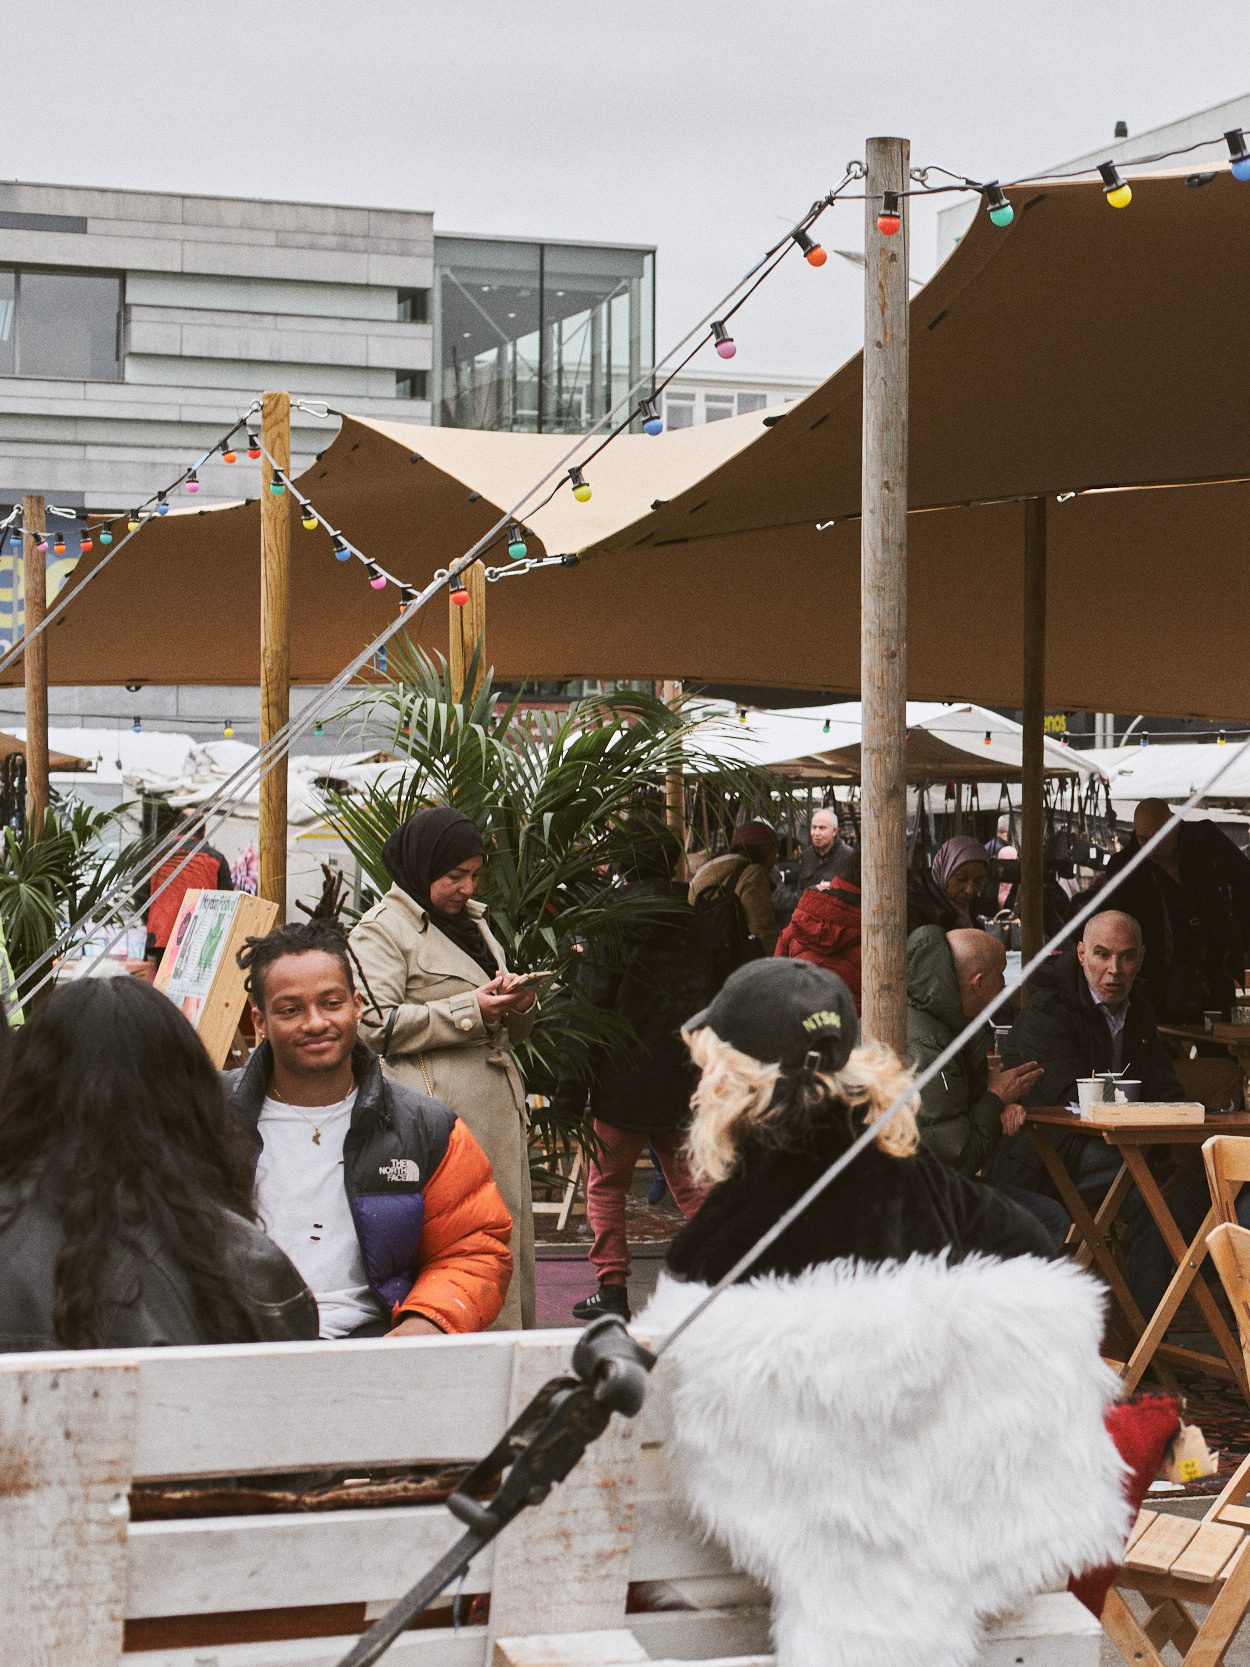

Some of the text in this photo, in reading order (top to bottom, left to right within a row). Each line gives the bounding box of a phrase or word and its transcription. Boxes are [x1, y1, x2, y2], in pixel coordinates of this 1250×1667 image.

[391, 1159, 407, 1168] THE
[379, 1166, 407, 1175] NORTH
[387, 1174, 407, 1182] FACE
